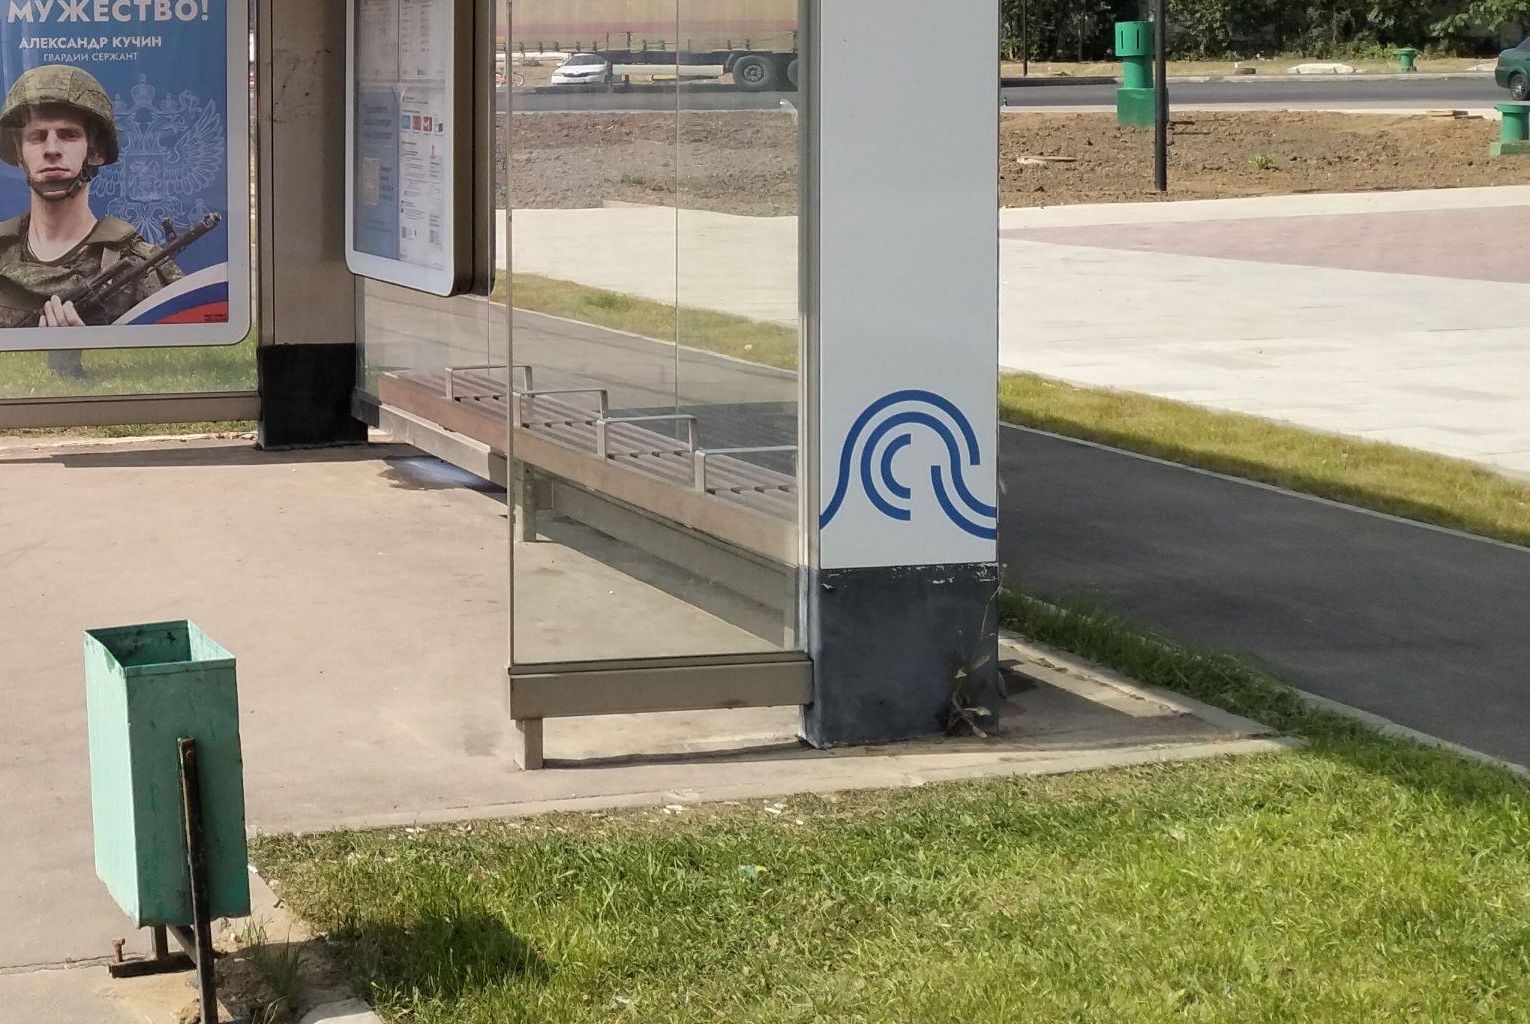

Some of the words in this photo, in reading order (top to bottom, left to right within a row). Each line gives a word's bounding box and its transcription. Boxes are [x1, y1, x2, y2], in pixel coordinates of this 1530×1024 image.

[18, 37, 107, 50] АЛЕКСАНДР
[112, 36, 162, 48] КУЧИН
[43, 52, 89, 62] ГВАРДИИ
[92, 51, 138, 61] СЕРЖАНТ
